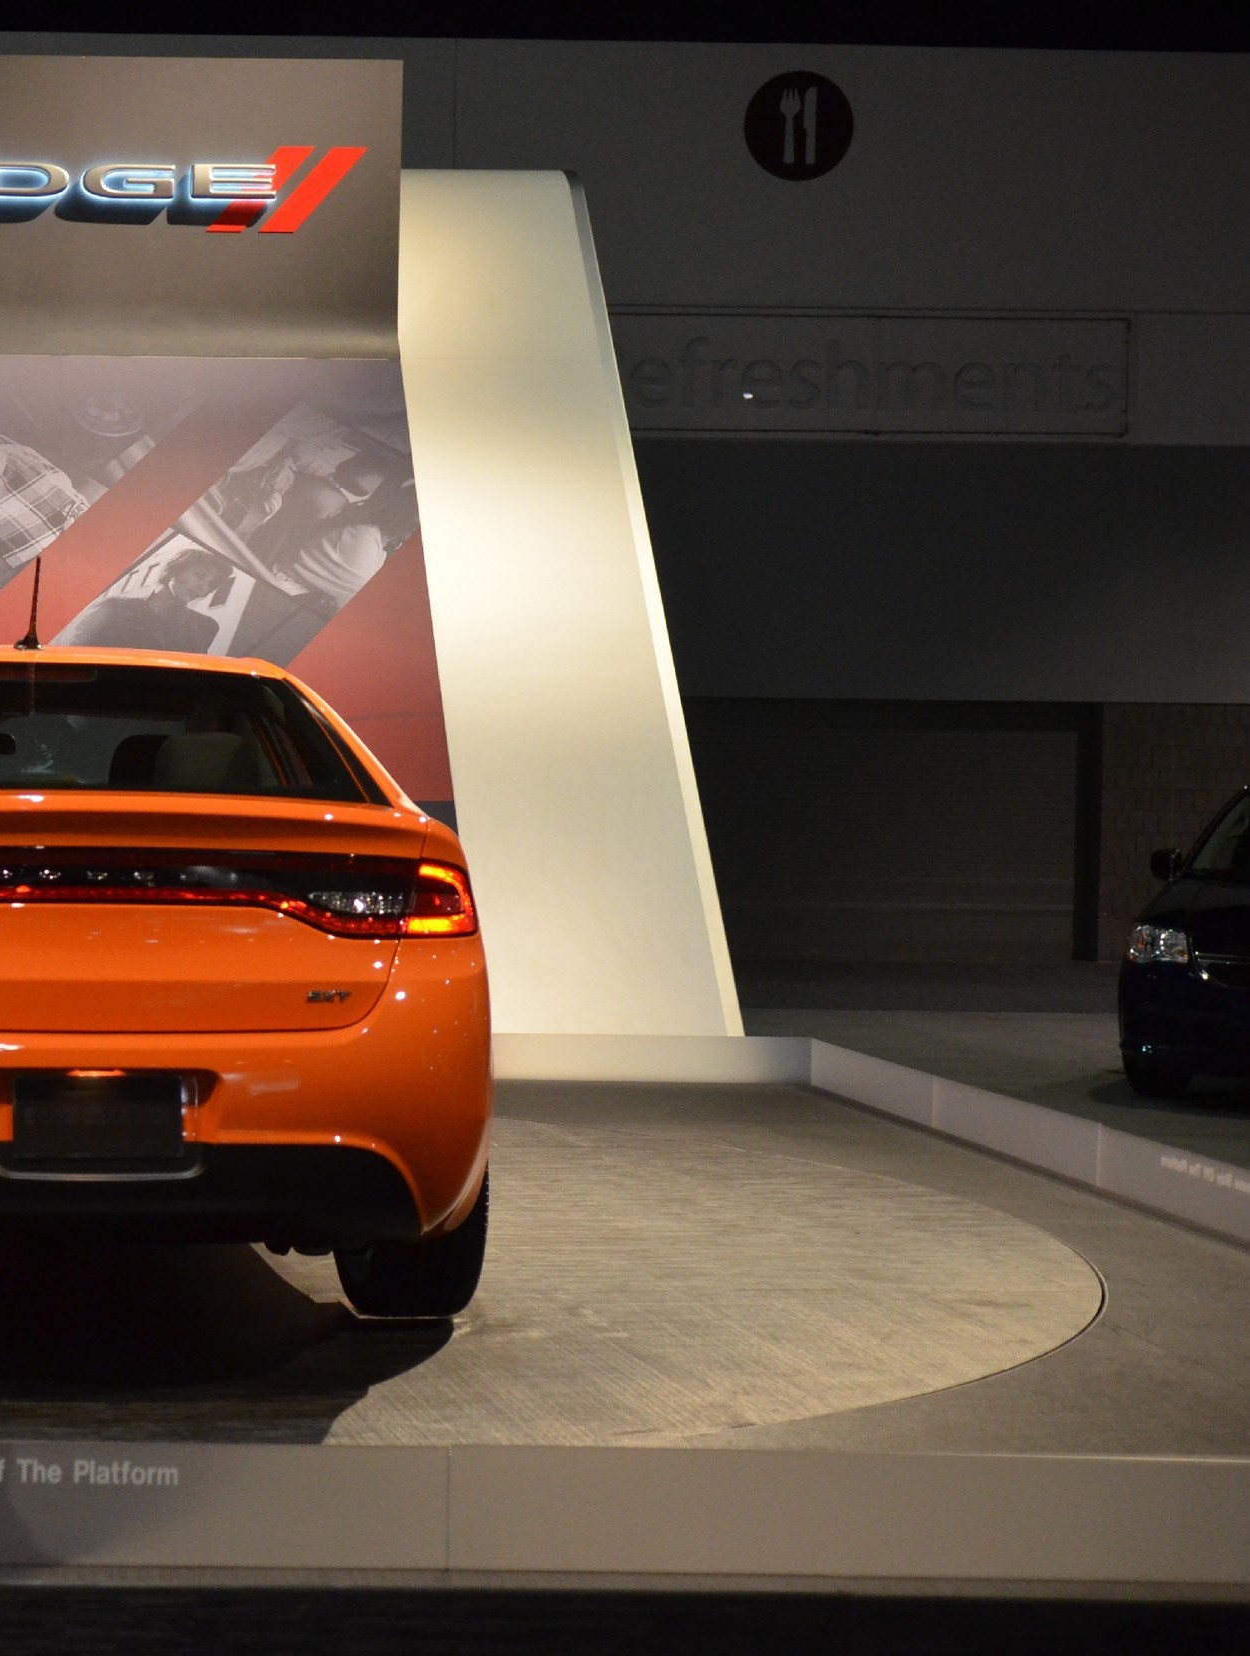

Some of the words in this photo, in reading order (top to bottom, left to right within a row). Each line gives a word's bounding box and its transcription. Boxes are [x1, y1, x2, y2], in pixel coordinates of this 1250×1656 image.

[616, 335, 1119, 413] efreshments
[16, 1457, 63, 1484] The
[73, 1459, 180, 1487] Platform
